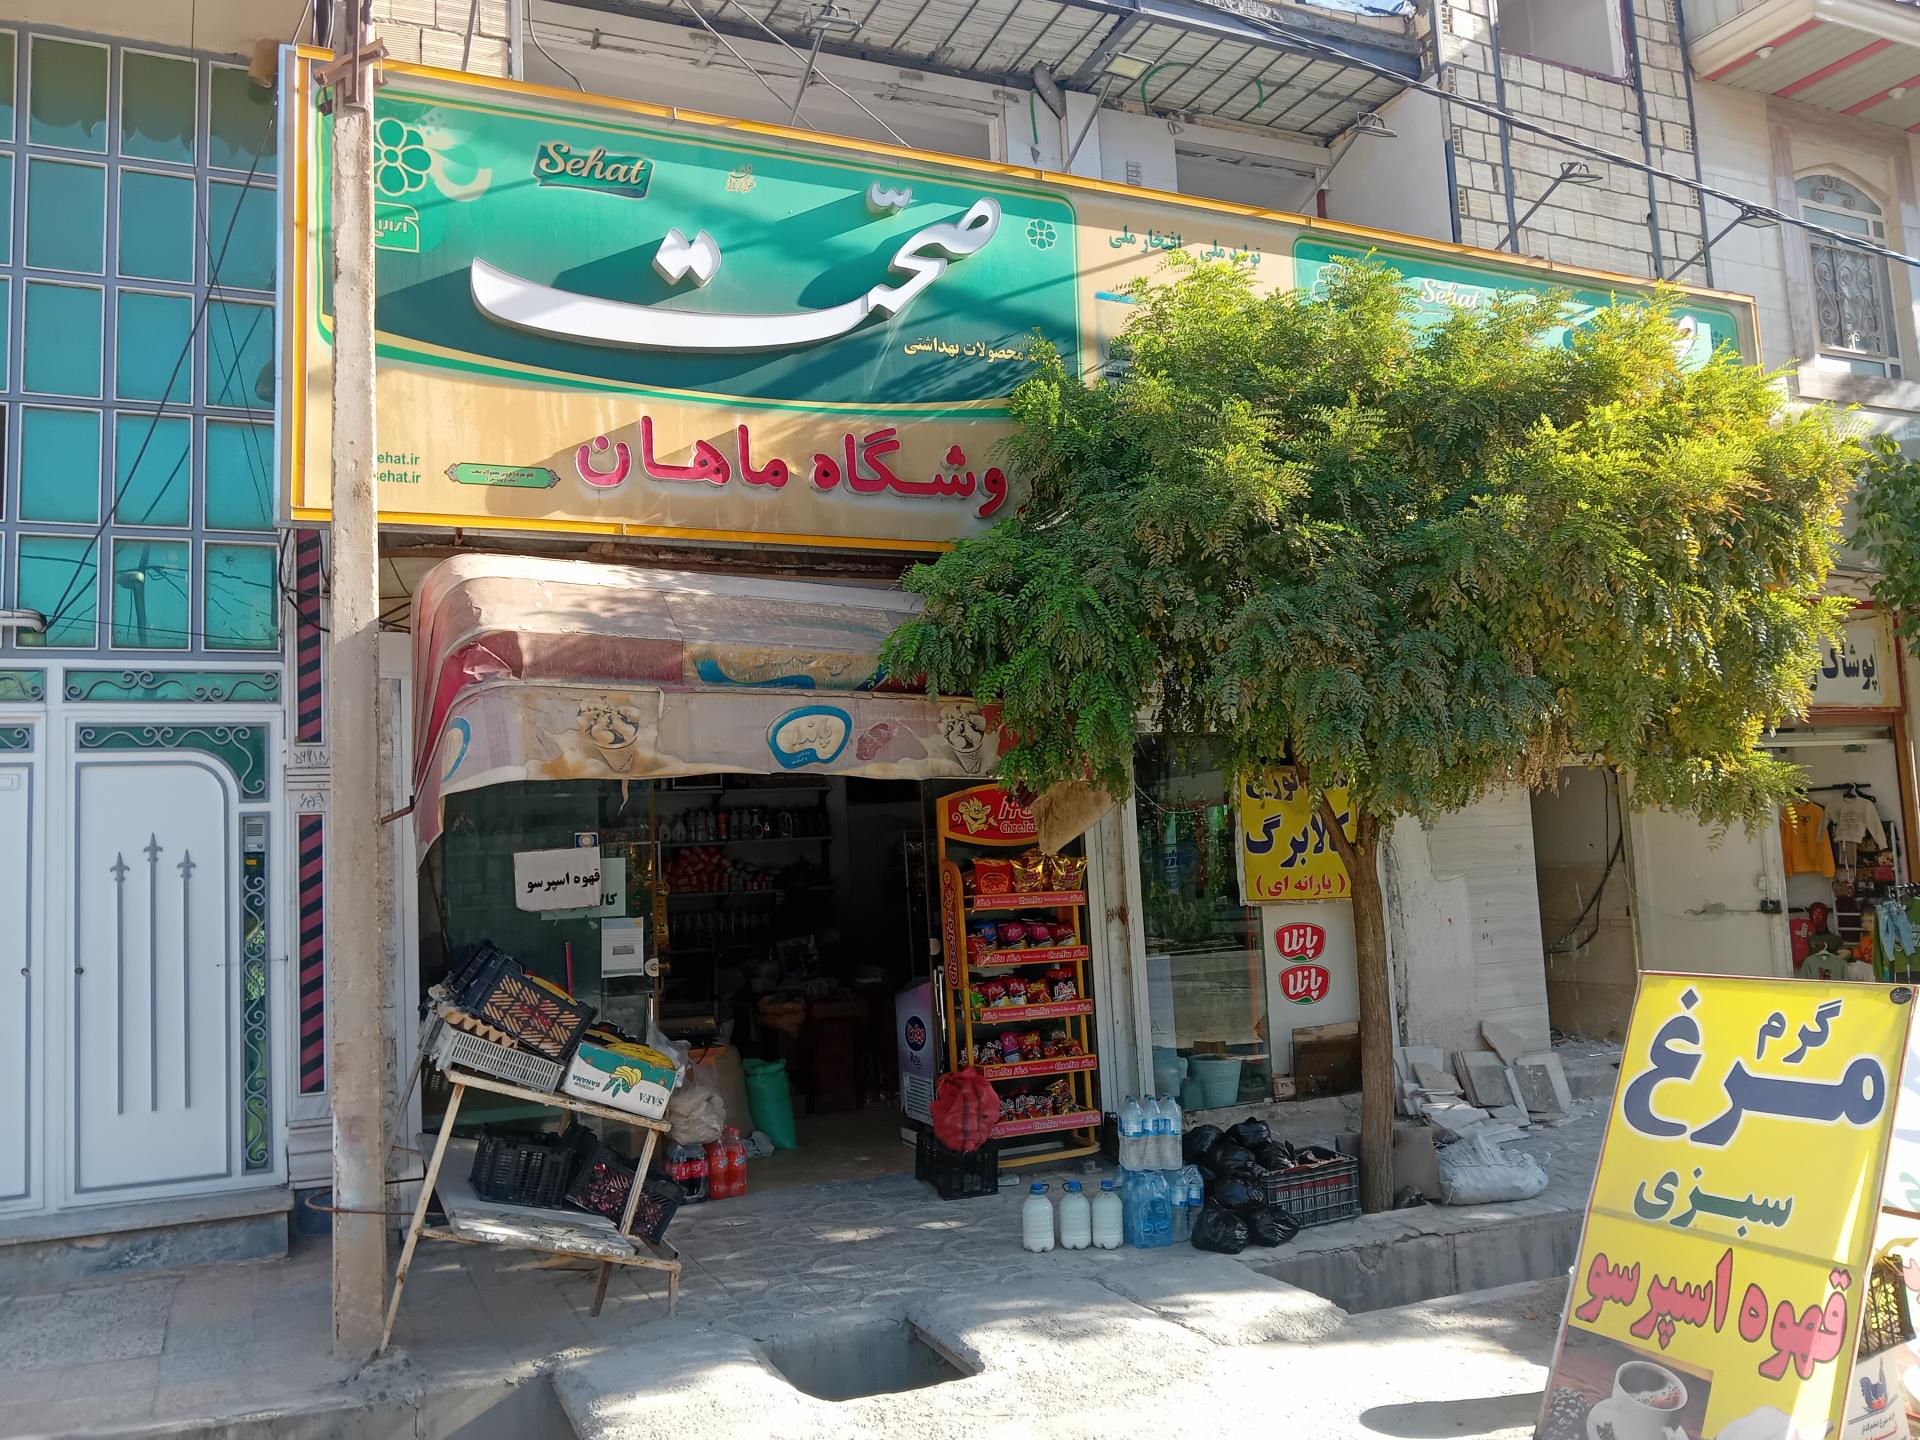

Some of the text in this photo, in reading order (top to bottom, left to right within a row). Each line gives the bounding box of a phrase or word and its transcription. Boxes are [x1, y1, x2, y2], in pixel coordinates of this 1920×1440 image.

[539, 139, 648, 187] Sehat
[1109, 223, 1136, 249] ملی
[1140, 228, 1182, 254] افتخار
[1200, 239, 1225, 262] ملی
[1421, 278, 1481, 309] Sehat
[903, 335, 960, 359] بهداشتی
[963, 340, 1024, 363] محصولات
[376, 452, 420, 466] ehat.ir
[575, 415, 1010, 518] وشگاه ماهان
[376, 470, 422, 484] ehat.ir
[527, 868, 600, 893] قهوه اسپرسو
[1756, 998, 1842, 1064] گرم
[1622, 985, 1886, 1147] مرغ
[572, 1074, 601, 1088] BANANA
[1633, 1164, 1794, 1240] سبزی
[1575, 1247, 1853, 1381] قهوه اسپرسو
